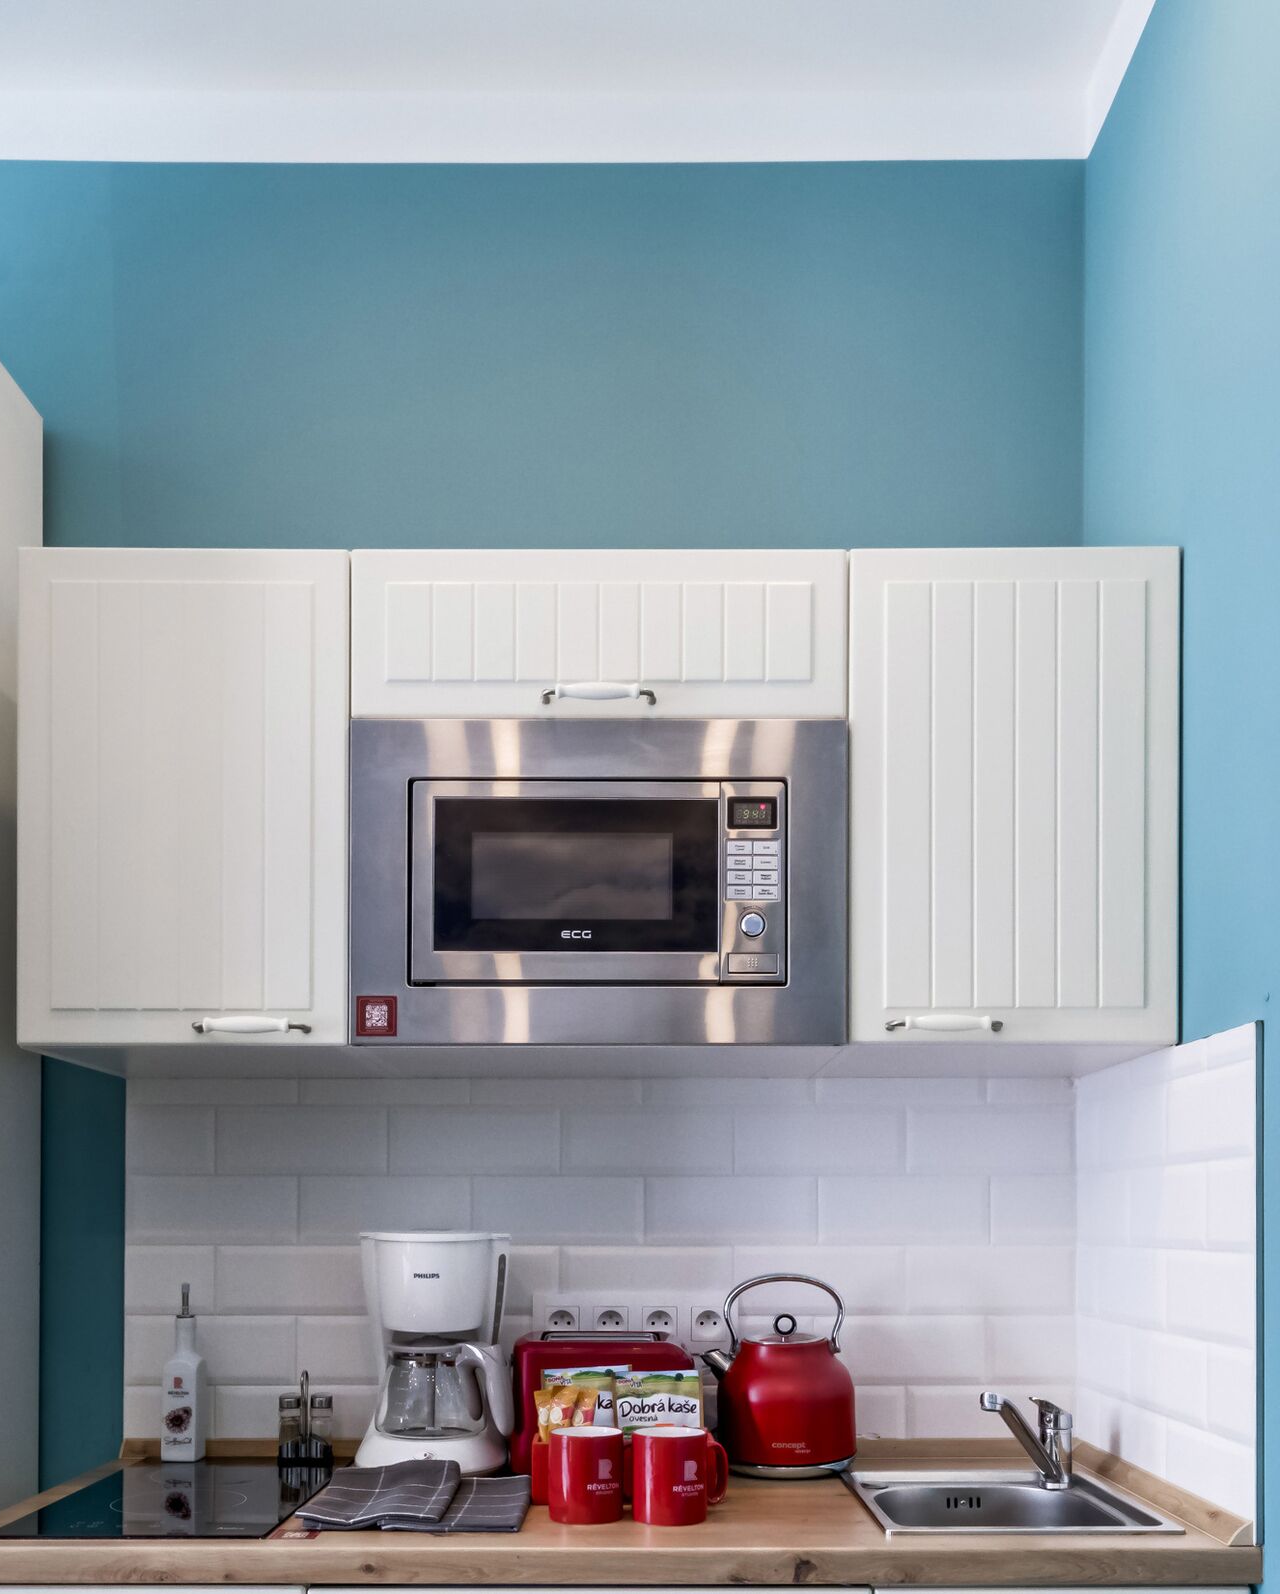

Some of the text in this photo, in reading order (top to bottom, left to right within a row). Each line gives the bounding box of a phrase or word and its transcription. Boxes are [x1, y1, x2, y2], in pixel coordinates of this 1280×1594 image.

[561, 930, 592, 939] ECG
[597, 1394, 613, 1410] ka
[619, 1397, 697, 1418] Dobrá kaše
[629, 1414, 658, 1423] ovesná
[771, 1441, 806, 1450] concept
